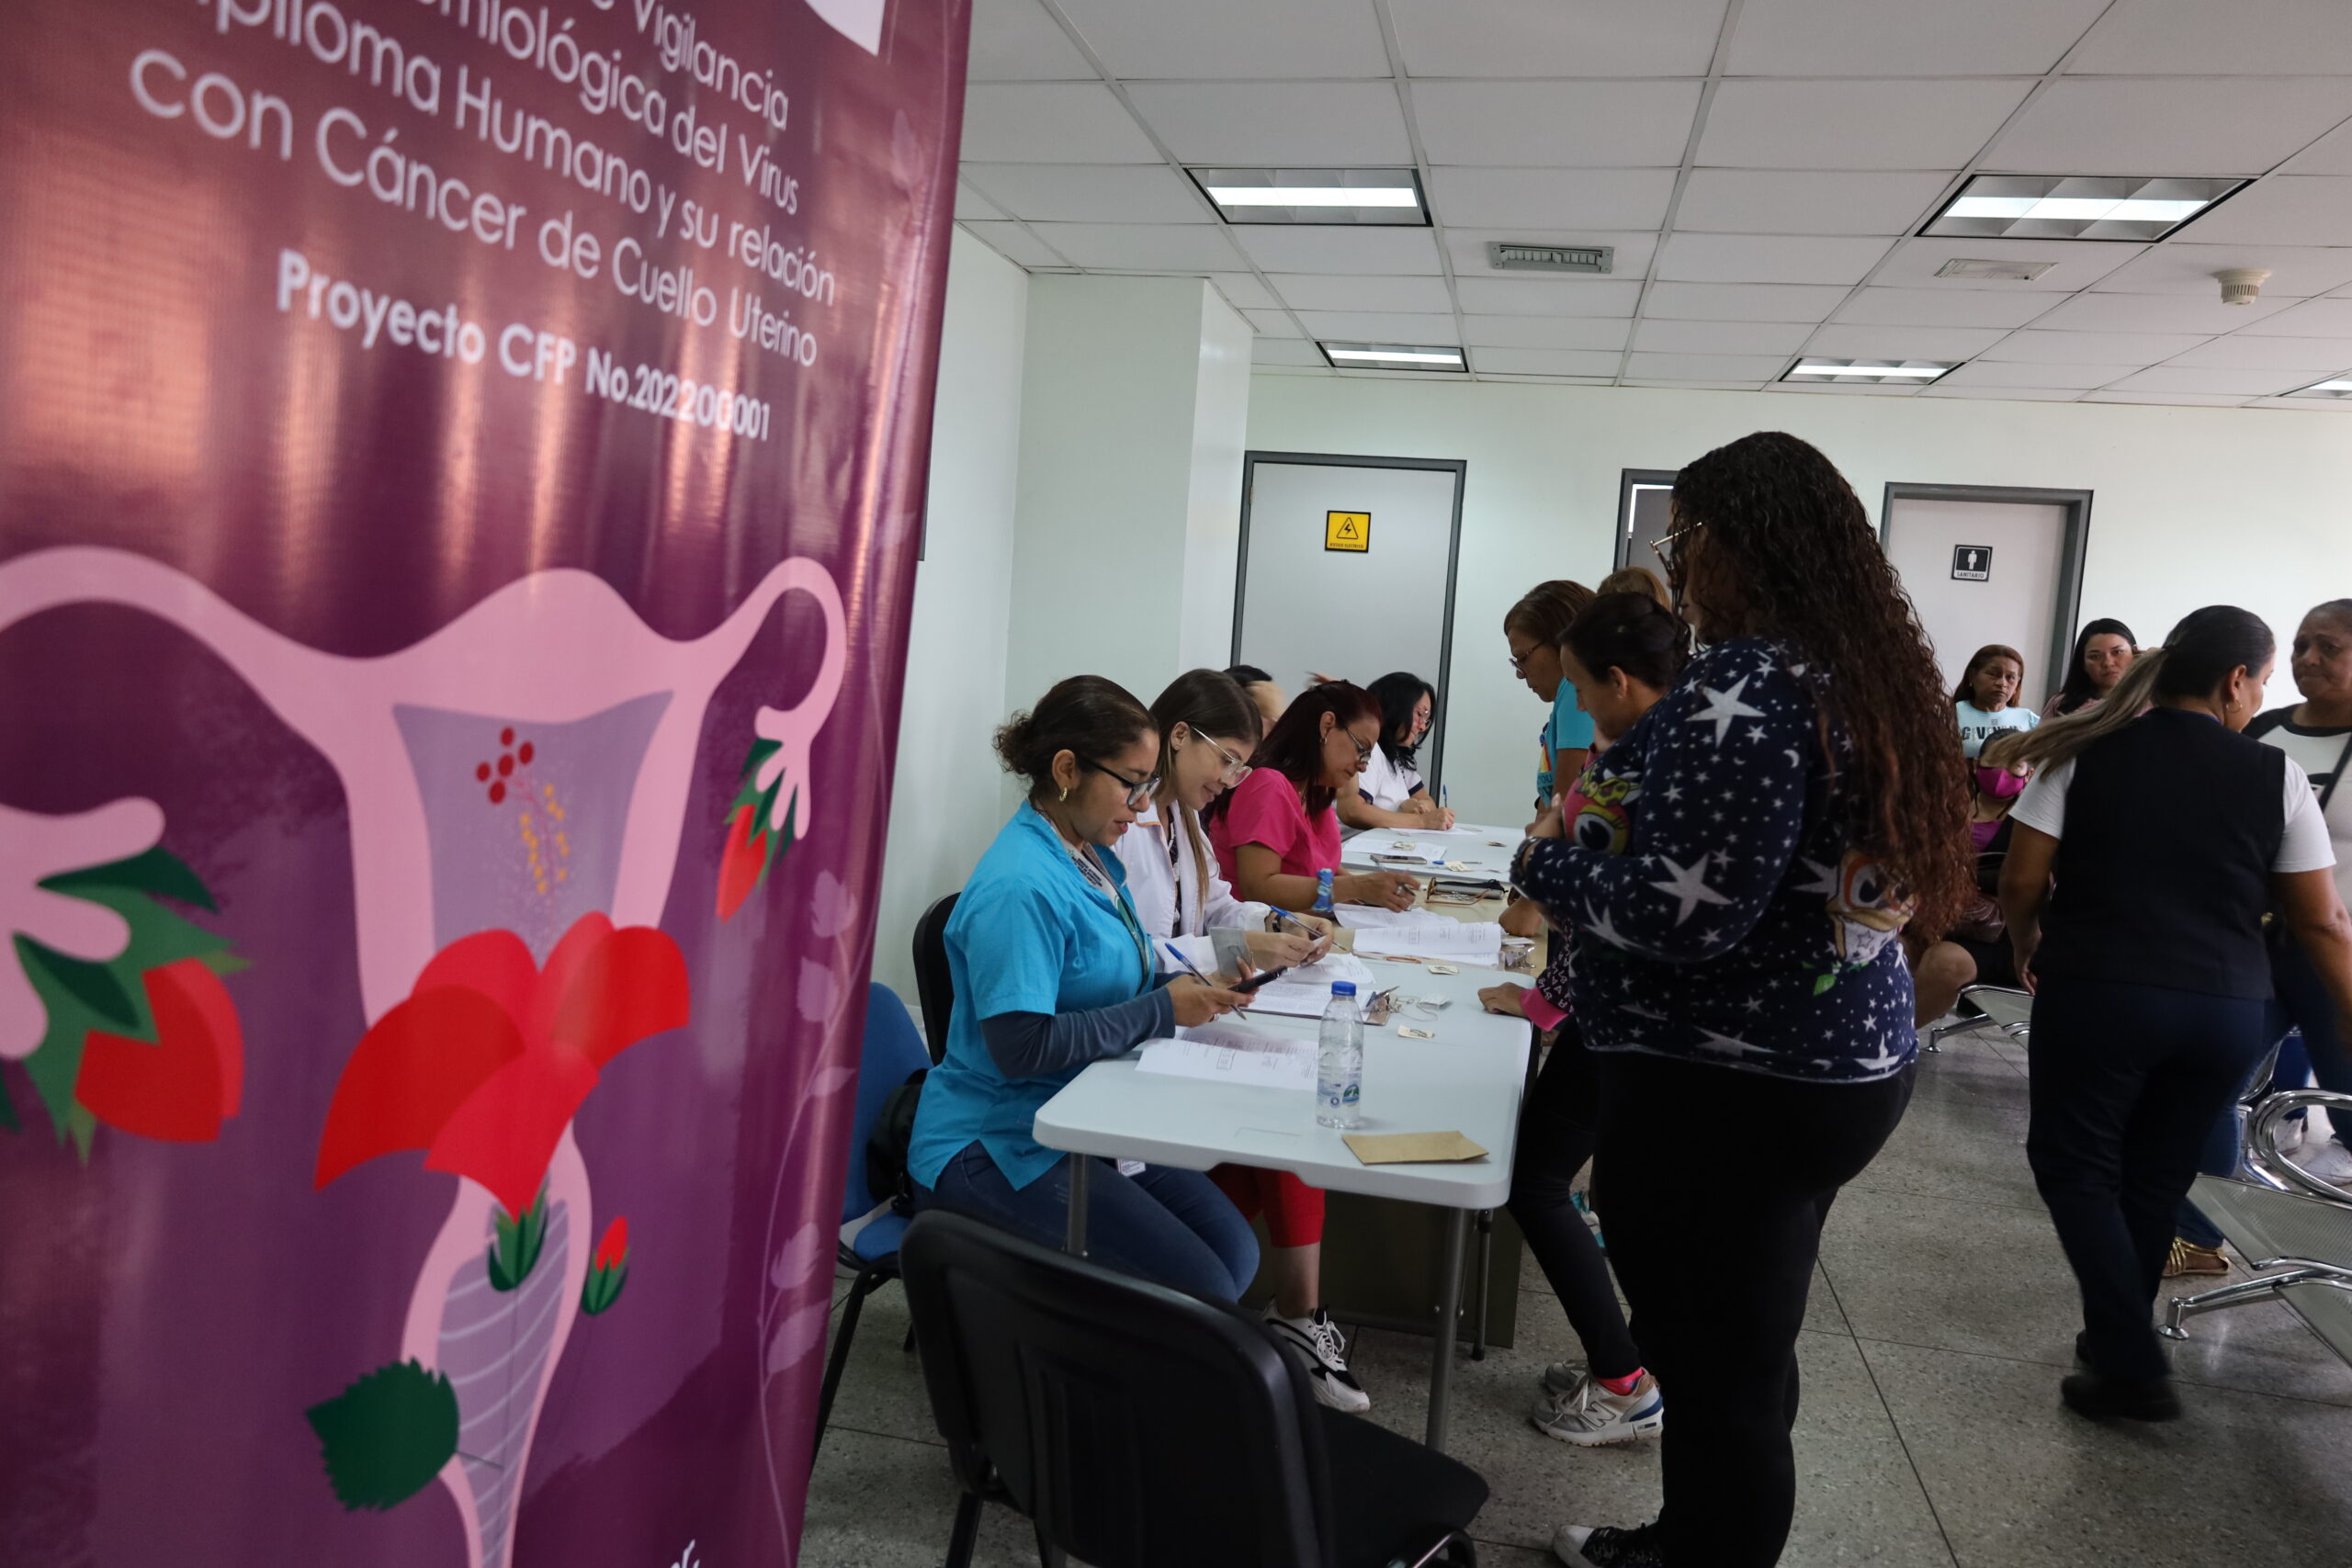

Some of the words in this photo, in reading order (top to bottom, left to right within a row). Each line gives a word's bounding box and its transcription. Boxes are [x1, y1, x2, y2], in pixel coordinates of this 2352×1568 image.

[634, 0, 788, 131] Vigilancia
[130, 49, 293, 161] con
[316, 107, 526, 250] Cáncer
[538, 210, 601, 279] de
[612, 237, 718, 327] Cuello
[729, 287, 818, 367] Uterino
[456, 64, 651, 213] Humano
[657, 184, 676, 239] y
[680, 199, 718, 249] su
[728, 220, 835, 306] relación
[672, 104, 728, 175] del
[739, 133, 799, 216] Virus
[277, 248, 486, 366] Proyecto
[499, 323, 577, 387] CFP
